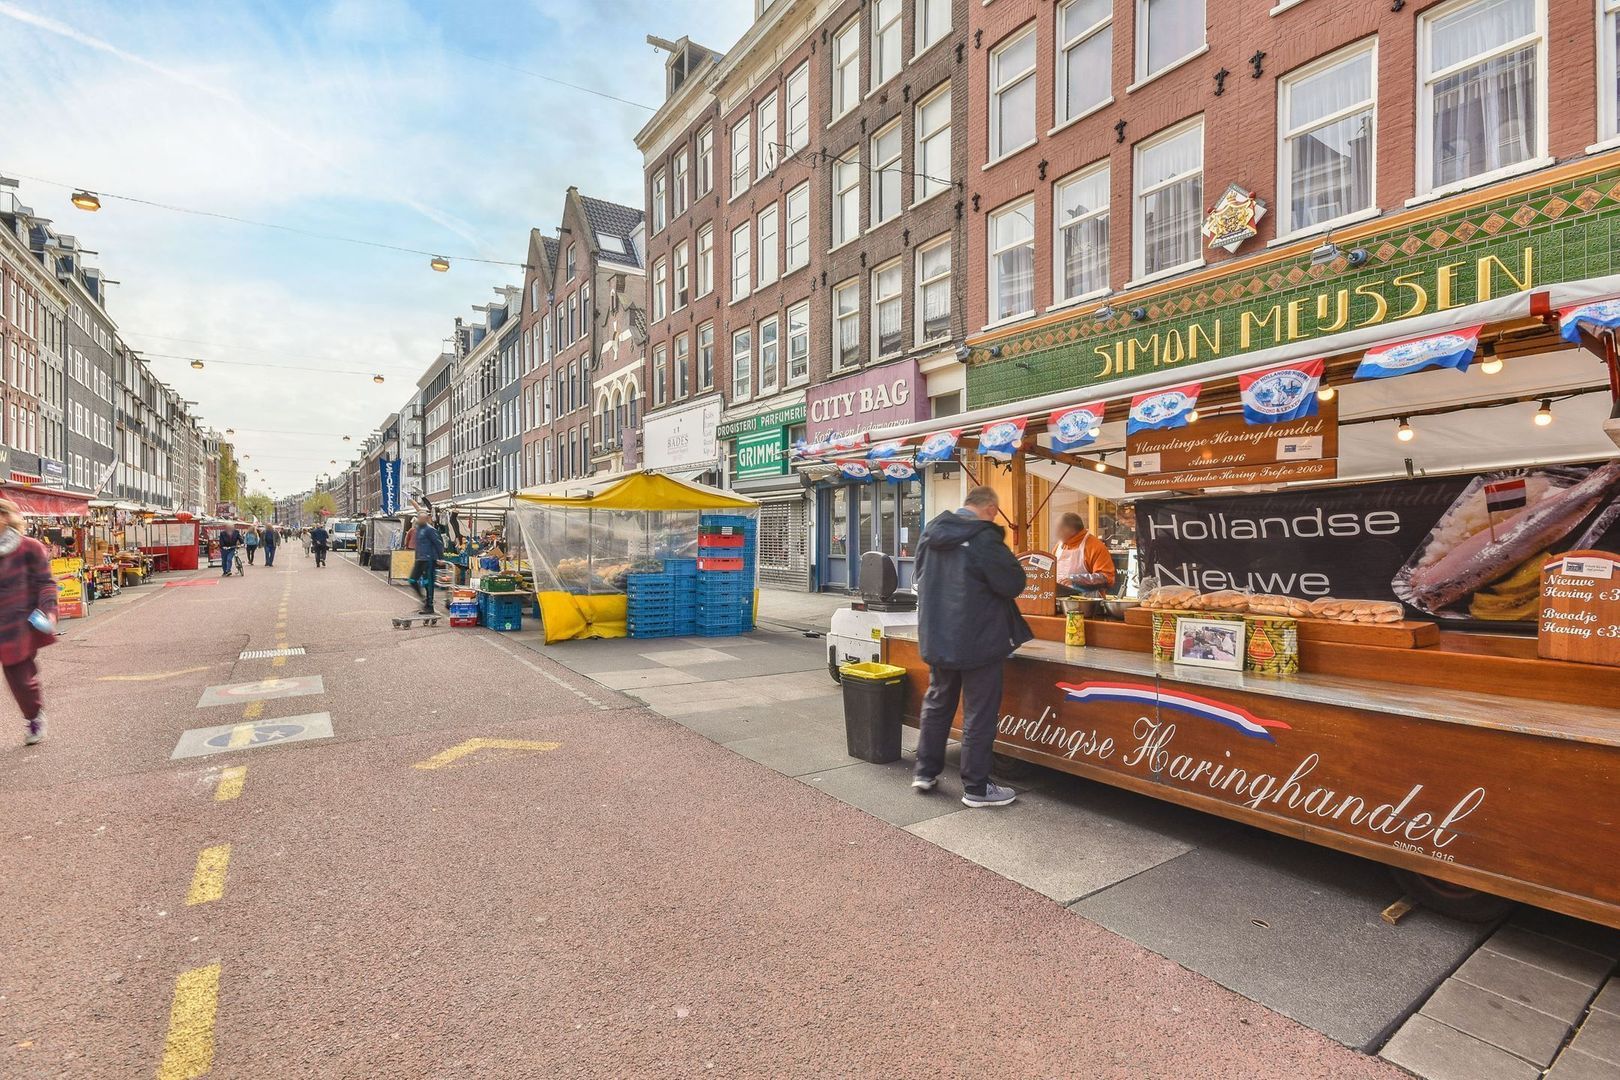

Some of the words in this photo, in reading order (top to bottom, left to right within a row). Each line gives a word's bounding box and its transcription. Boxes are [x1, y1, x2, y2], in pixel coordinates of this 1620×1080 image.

[1094, 319, 1220, 378] SIMON
[811, 392, 855, 423] CITY
[859, 379, 909, 414] BAG
[717, 418, 758, 437] DROGISTERIJ
[760, 405, 806, 427] PARFUMERIE
[1136, 437, 1208, 454] Vlaardingse
[1210, 419, 1324, 445] Haringhandel
[738, 441, 782, 468] GRIMME
[1188, 456, 1220, 467] Anno
[1222, 453, 1246, 464] 1916
[1171, 474, 1218, 484] Hollandse
[1219, 471, 1257, 481] Haring
[1259, 466, 1293, 477] Trofee
[1296, 465, 1323, 474] 2003
[1148, 507, 1400, 541] Hollandse
[1152, 562, 1330, 596] Nieuwe
[1544, 574, 1596, 587] Nieuwe
[1543, 586, 1594, 602] Haring
[1542, 607, 1598, 624] Broodje
[1541, 621, 1593, 638] Haring
[997, 705, 1115, 760] ardingse
[1123, 716, 1485, 849] Haringhandel
[1393, 840, 1424, 855] SINDS
[1431, 850, 1455, 863] 1916
